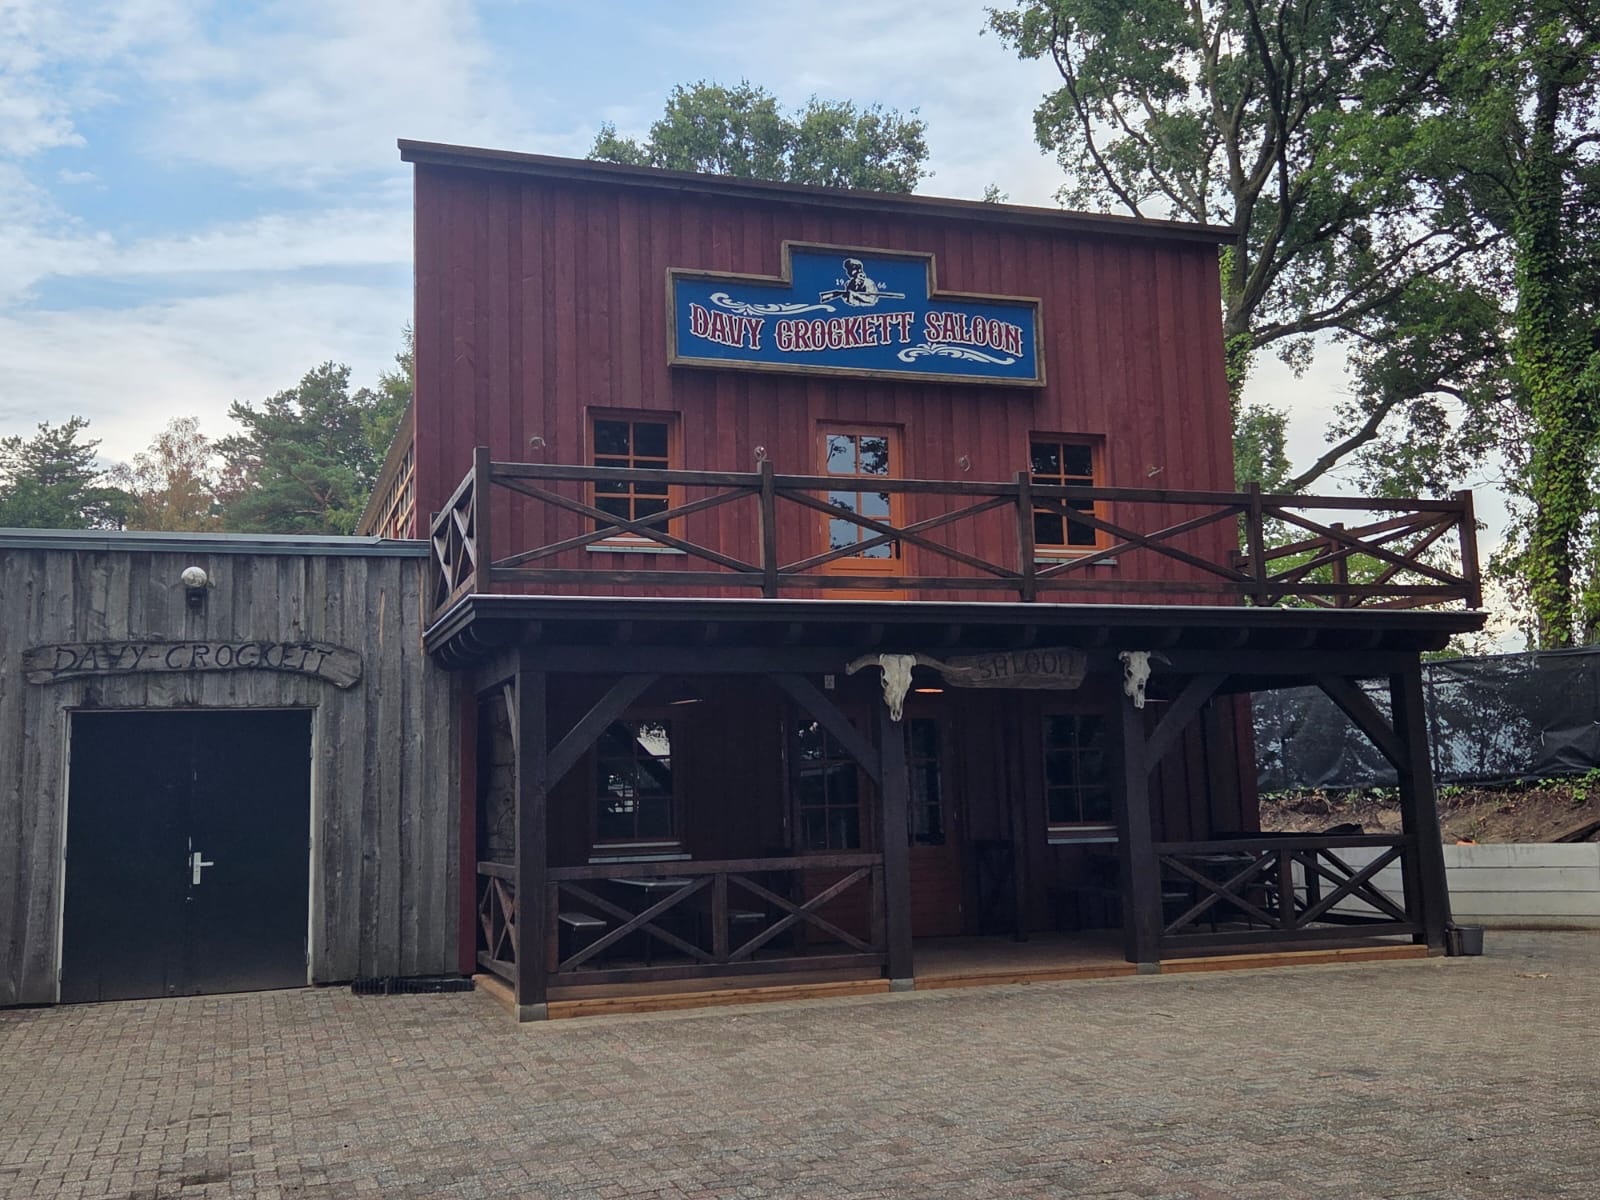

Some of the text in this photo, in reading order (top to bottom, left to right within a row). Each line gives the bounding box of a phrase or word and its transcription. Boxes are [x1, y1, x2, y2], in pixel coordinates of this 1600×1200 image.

[835, 278, 845, 286] 19
[689, 303, 1025, 357] DAVY CROCKETT SALOON
[978, 652, 1074, 679] SALOON
